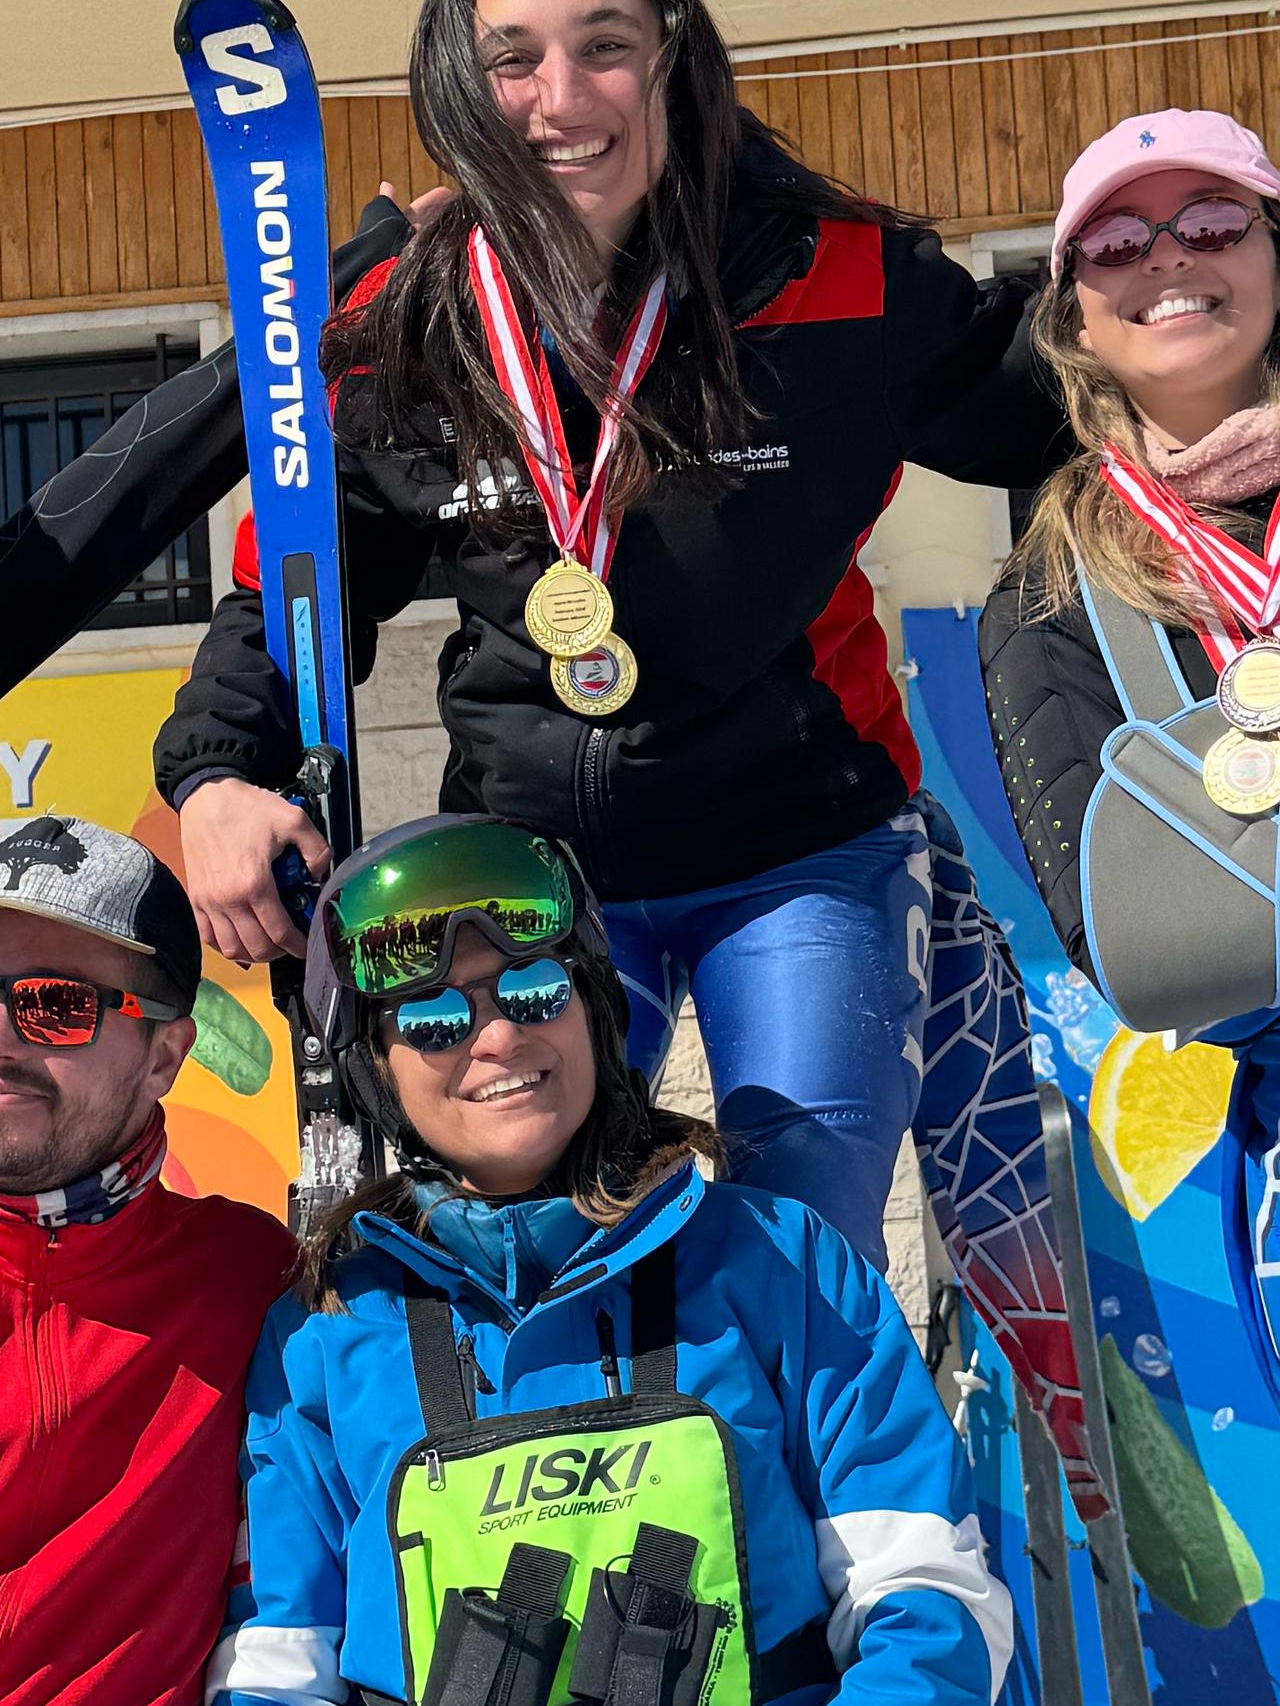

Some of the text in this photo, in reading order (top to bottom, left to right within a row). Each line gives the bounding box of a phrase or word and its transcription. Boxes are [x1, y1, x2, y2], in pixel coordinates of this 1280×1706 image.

[251, 159, 310, 490] SALOMON
[477, 1492, 639, 1536] SPORT EQUIPMENT
[479, 1440, 653, 1517] LISKI
